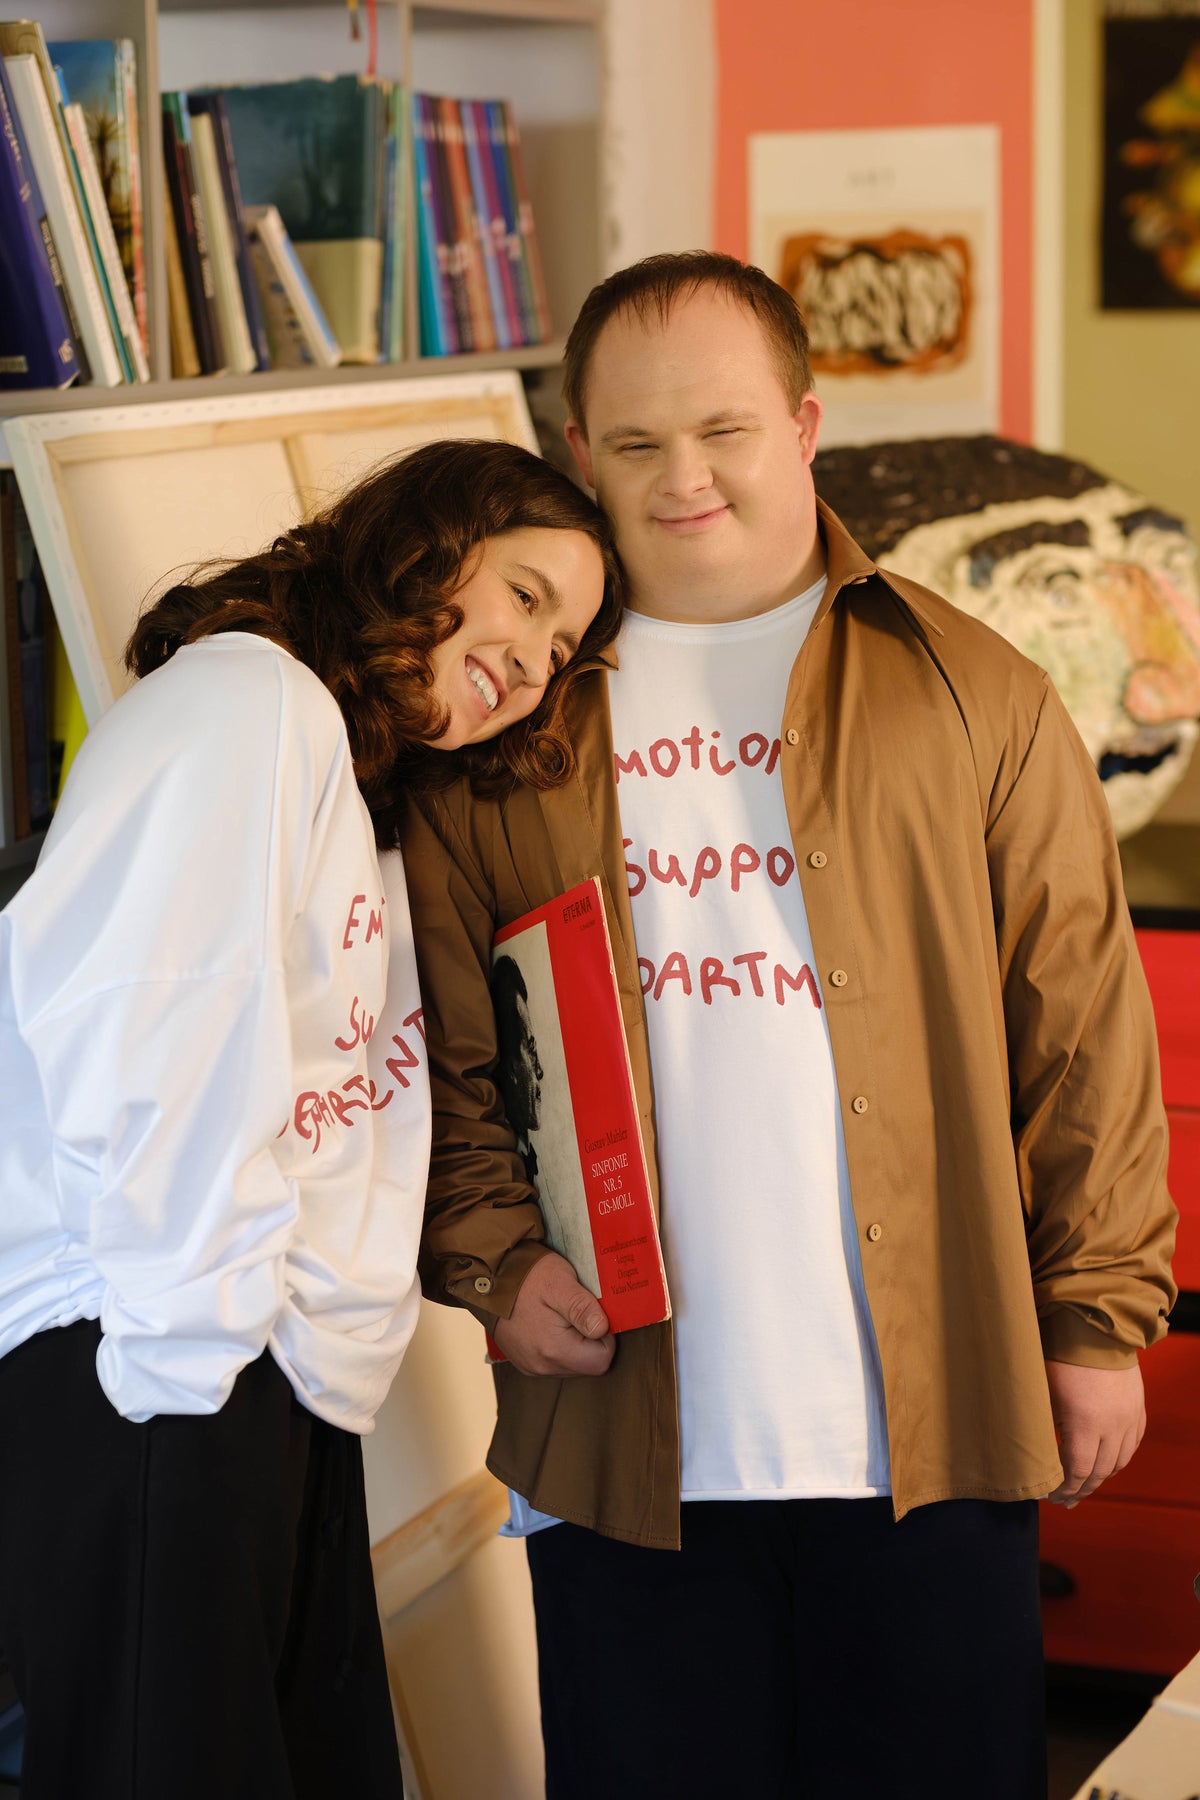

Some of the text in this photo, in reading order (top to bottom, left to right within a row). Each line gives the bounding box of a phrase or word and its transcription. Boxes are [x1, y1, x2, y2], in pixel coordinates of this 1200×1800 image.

[562, 896, 592, 924] ETERNA
[585, 1128, 628, 1154] Gustav Mahler
[592, 1152, 629, 1178] SINFONIE
[618, 1175, 623, 1189] 5
[598, 1192, 635, 1216] CIS-MOLL
